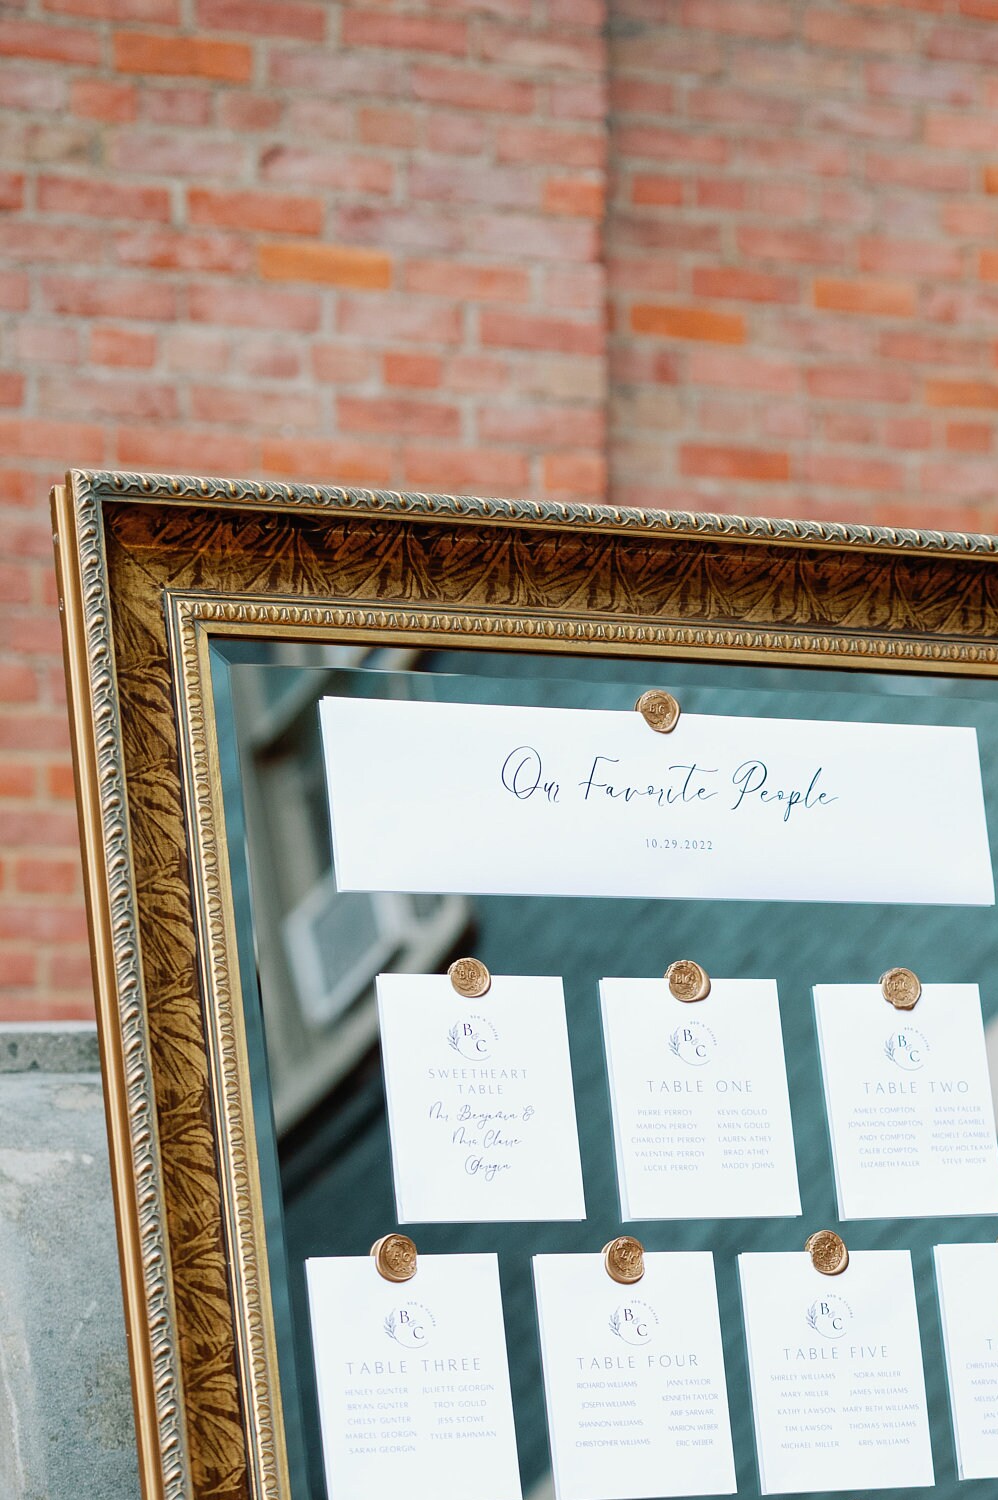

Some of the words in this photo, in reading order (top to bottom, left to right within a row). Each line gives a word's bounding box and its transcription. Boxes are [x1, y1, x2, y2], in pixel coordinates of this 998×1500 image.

[502, 746, 560, 803] Our
[579, 756, 718, 807] Favorite
[731, 760, 839, 822] People
[646, 838, 713, 850] 10.29.2022
[427, 1068, 526, 1079] SWEETHEART
[457, 1084, 503, 1094] TABLE
[646, 1080, 703, 1092] TABLE
[715, 1079, 752, 1092] ONE
[863, 1081, 916, 1095] TABLE
[928, 1080, 968, 1093] TWO
[637, 1108, 663, 1116] PIERRE
[663, 1108, 692, 1116] PERROY
[716, 1108, 739, 1116] KEVIN
[738, 1108, 768, 1116] GOULD
[716, 1121, 742, 1130] KAREN
[743, 1121, 770, 1129] GOULD
[630, 1136, 676, 1144] CHARLOTTE
[676, 1136, 706, 1144] PERROY
[720, 1162, 749, 1170] MADDY
[751, 1161, 774, 1169] JOHNS
[783, 1346, 838, 1361] TABLE
[850, 1345, 887, 1358] FIVE
[346, 1360, 406, 1375] TABLE
[420, 1357, 480, 1372] THREE
[576, 1355, 635, 1370] TABLE
[647, 1353, 698, 1368] FOUR
[769, 1373, 797, 1381] SHIRLEY
[800, 1372, 836, 1380] WILLIAMS
[576, 1381, 606, 1389] RICHARD
[606, 1380, 638, 1388] WILLIAMS
[661, 1393, 691, 1402] KENNETH
[691, 1392, 720, 1401] TAYLOR
[432, 1400, 457, 1409] TROY
[457, 1399, 488, 1408] GOULD
[776, 1407, 803, 1416] KATHY
[803, 1406, 836, 1415] LAWSON
[346, 1416, 378, 1425] CHELSY
[379, 1415, 412, 1424] GUNTER
[437, 1416, 454, 1425] JESS
[455, 1415, 484, 1423] STOWE
[667, 1423, 696, 1432] MARION
[695, 1423, 719, 1431] WEBER
[784, 1424, 799, 1432] TIM
[798, 1423, 832, 1432] LAWSON
[429, 1431, 453, 1440] TYLER
[454, 1430, 496, 1438] BAHNMAN
[348, 1446, 376, 1455] SARAH
[378, 1444, 416, 1453] GEORGIN
